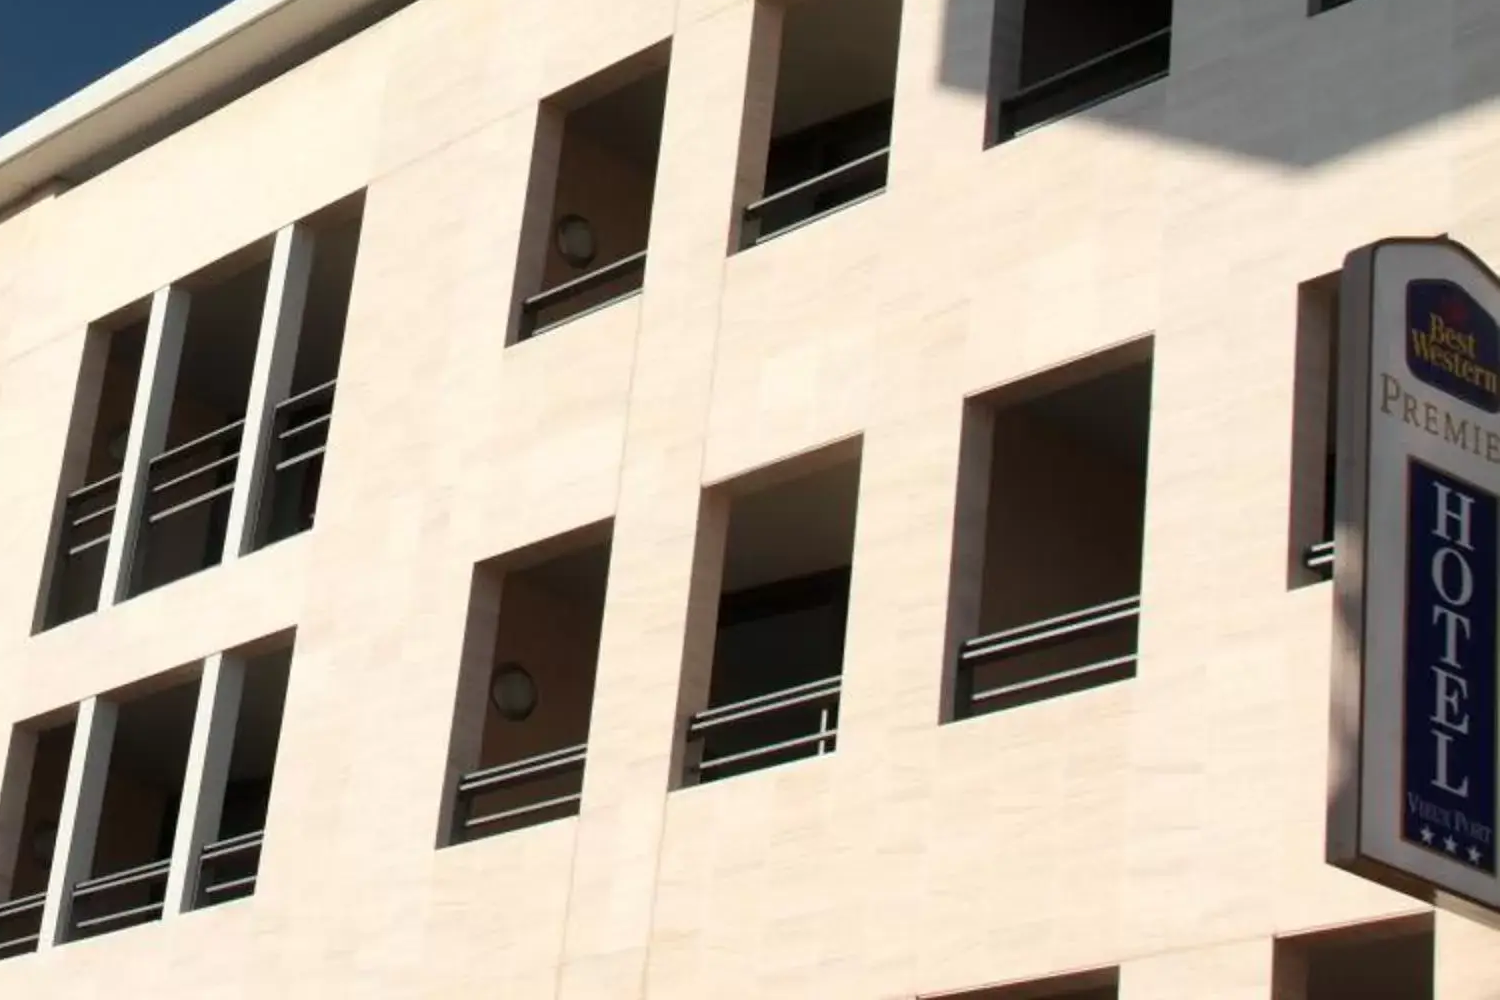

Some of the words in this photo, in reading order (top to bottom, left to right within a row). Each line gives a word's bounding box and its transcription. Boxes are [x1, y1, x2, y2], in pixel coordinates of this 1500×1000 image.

[1411, 328, 1498, 394] Western
[1429, 312, 1476, 358] Best
[1430, 481, 1476, 798] HOTEL
